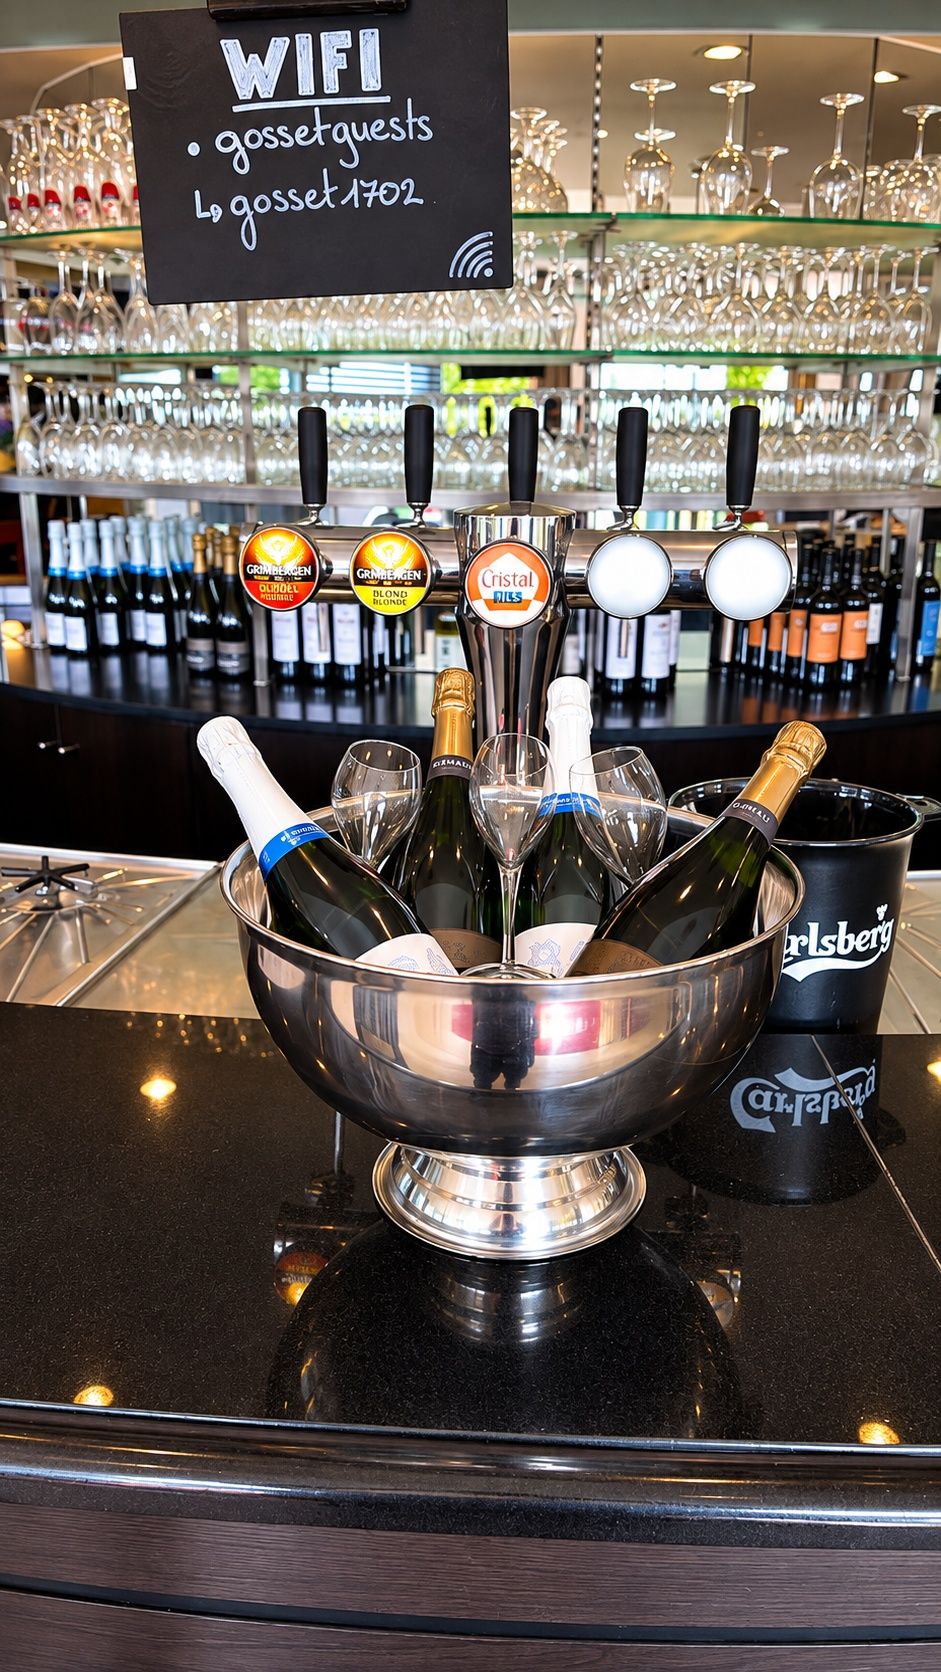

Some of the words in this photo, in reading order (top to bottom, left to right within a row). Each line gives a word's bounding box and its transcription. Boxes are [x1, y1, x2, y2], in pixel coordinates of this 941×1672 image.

[220, 28, 382, 100] WIFI
[215, 98, 433, 175] gossetguests
[482, 568, 534, 588] Cristal
[373, 589, 408, 598] BLOND
[373, 598, 408, 606] BLONDE
